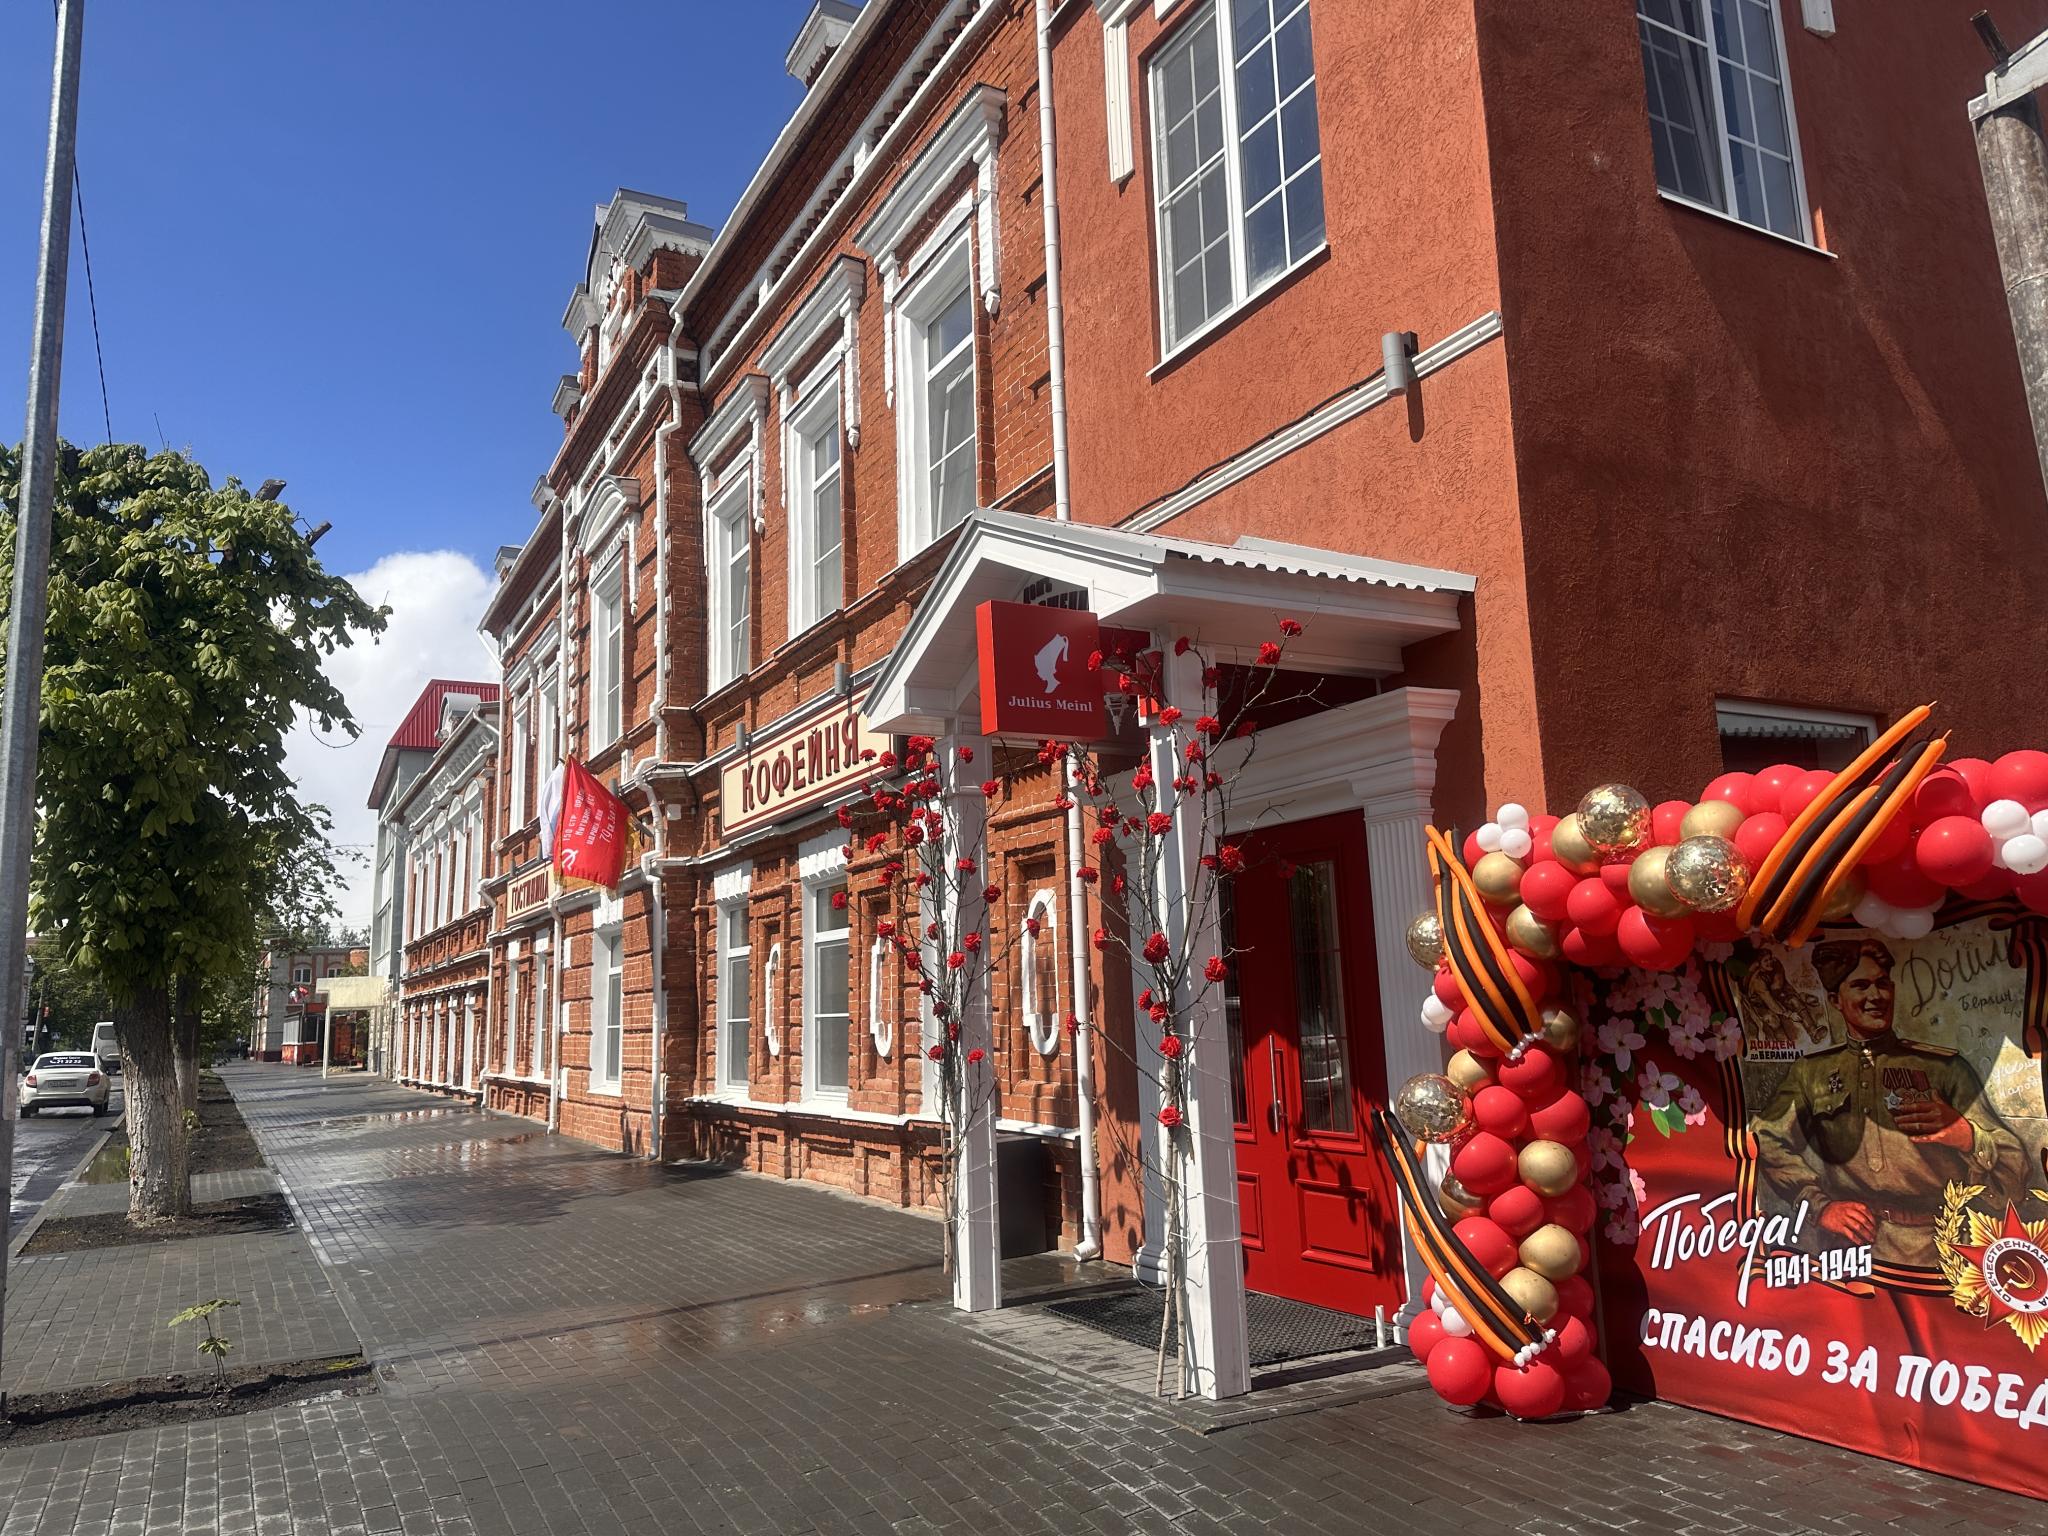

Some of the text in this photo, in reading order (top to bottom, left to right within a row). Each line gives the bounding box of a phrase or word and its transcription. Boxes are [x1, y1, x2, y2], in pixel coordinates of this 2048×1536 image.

[1008, 695, 1093, 712] Julius Meinl
[742, 711, 860, 814] КОФЕЙНЯ
[1642, 1192, 1809, 1308] Победа!
[1764, 1244, 1872, 1289] 1941-1945
[1986, 1240, 2048, 1303] ОТЕЧЕСТВЕННАЯ
[1640, 1308, 1811, 1377] СПАСИБО
[1821, 1340, 1879, 1393] ЗА
